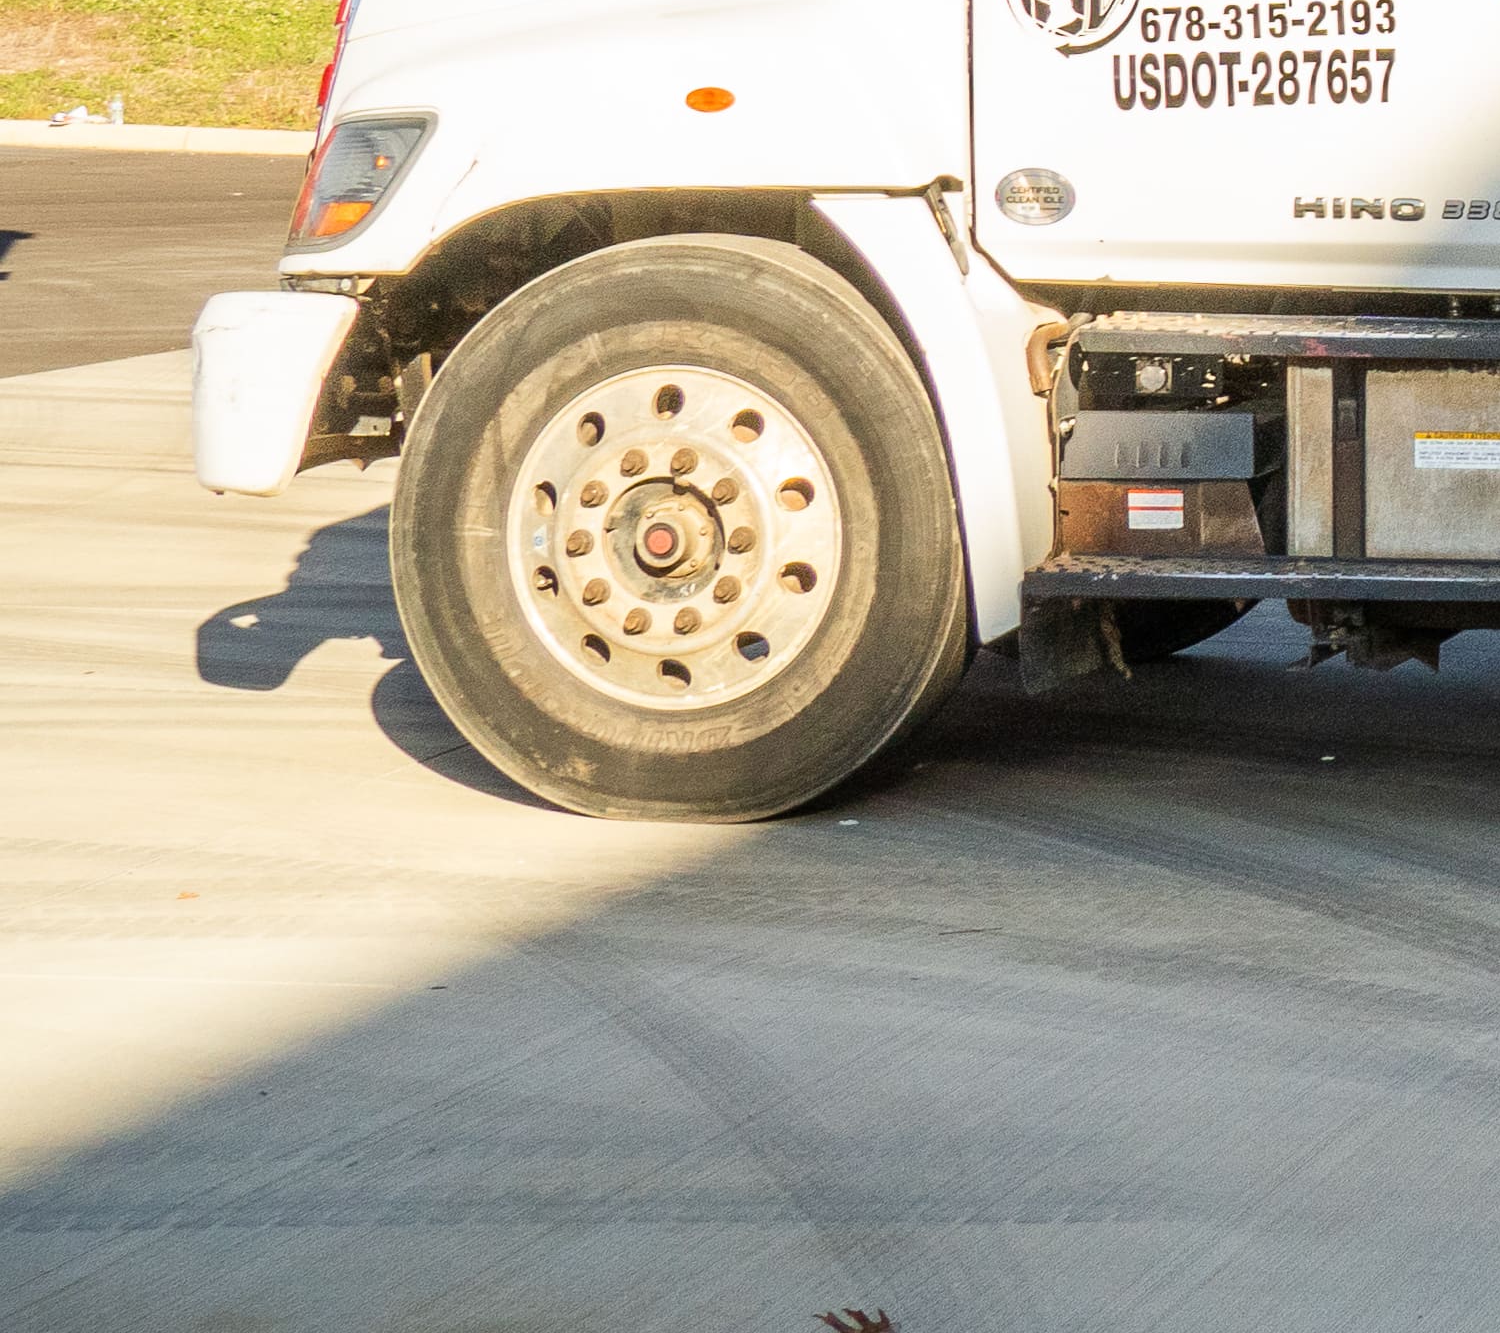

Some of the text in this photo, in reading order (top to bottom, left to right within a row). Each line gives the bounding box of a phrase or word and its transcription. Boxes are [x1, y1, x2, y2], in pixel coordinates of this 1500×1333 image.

[1140, 0, 1396, 43] 678-315-2193
[1113, 48, 1397, 111] USDOT-287657
[1293, 197, 1426, 221] HINO
